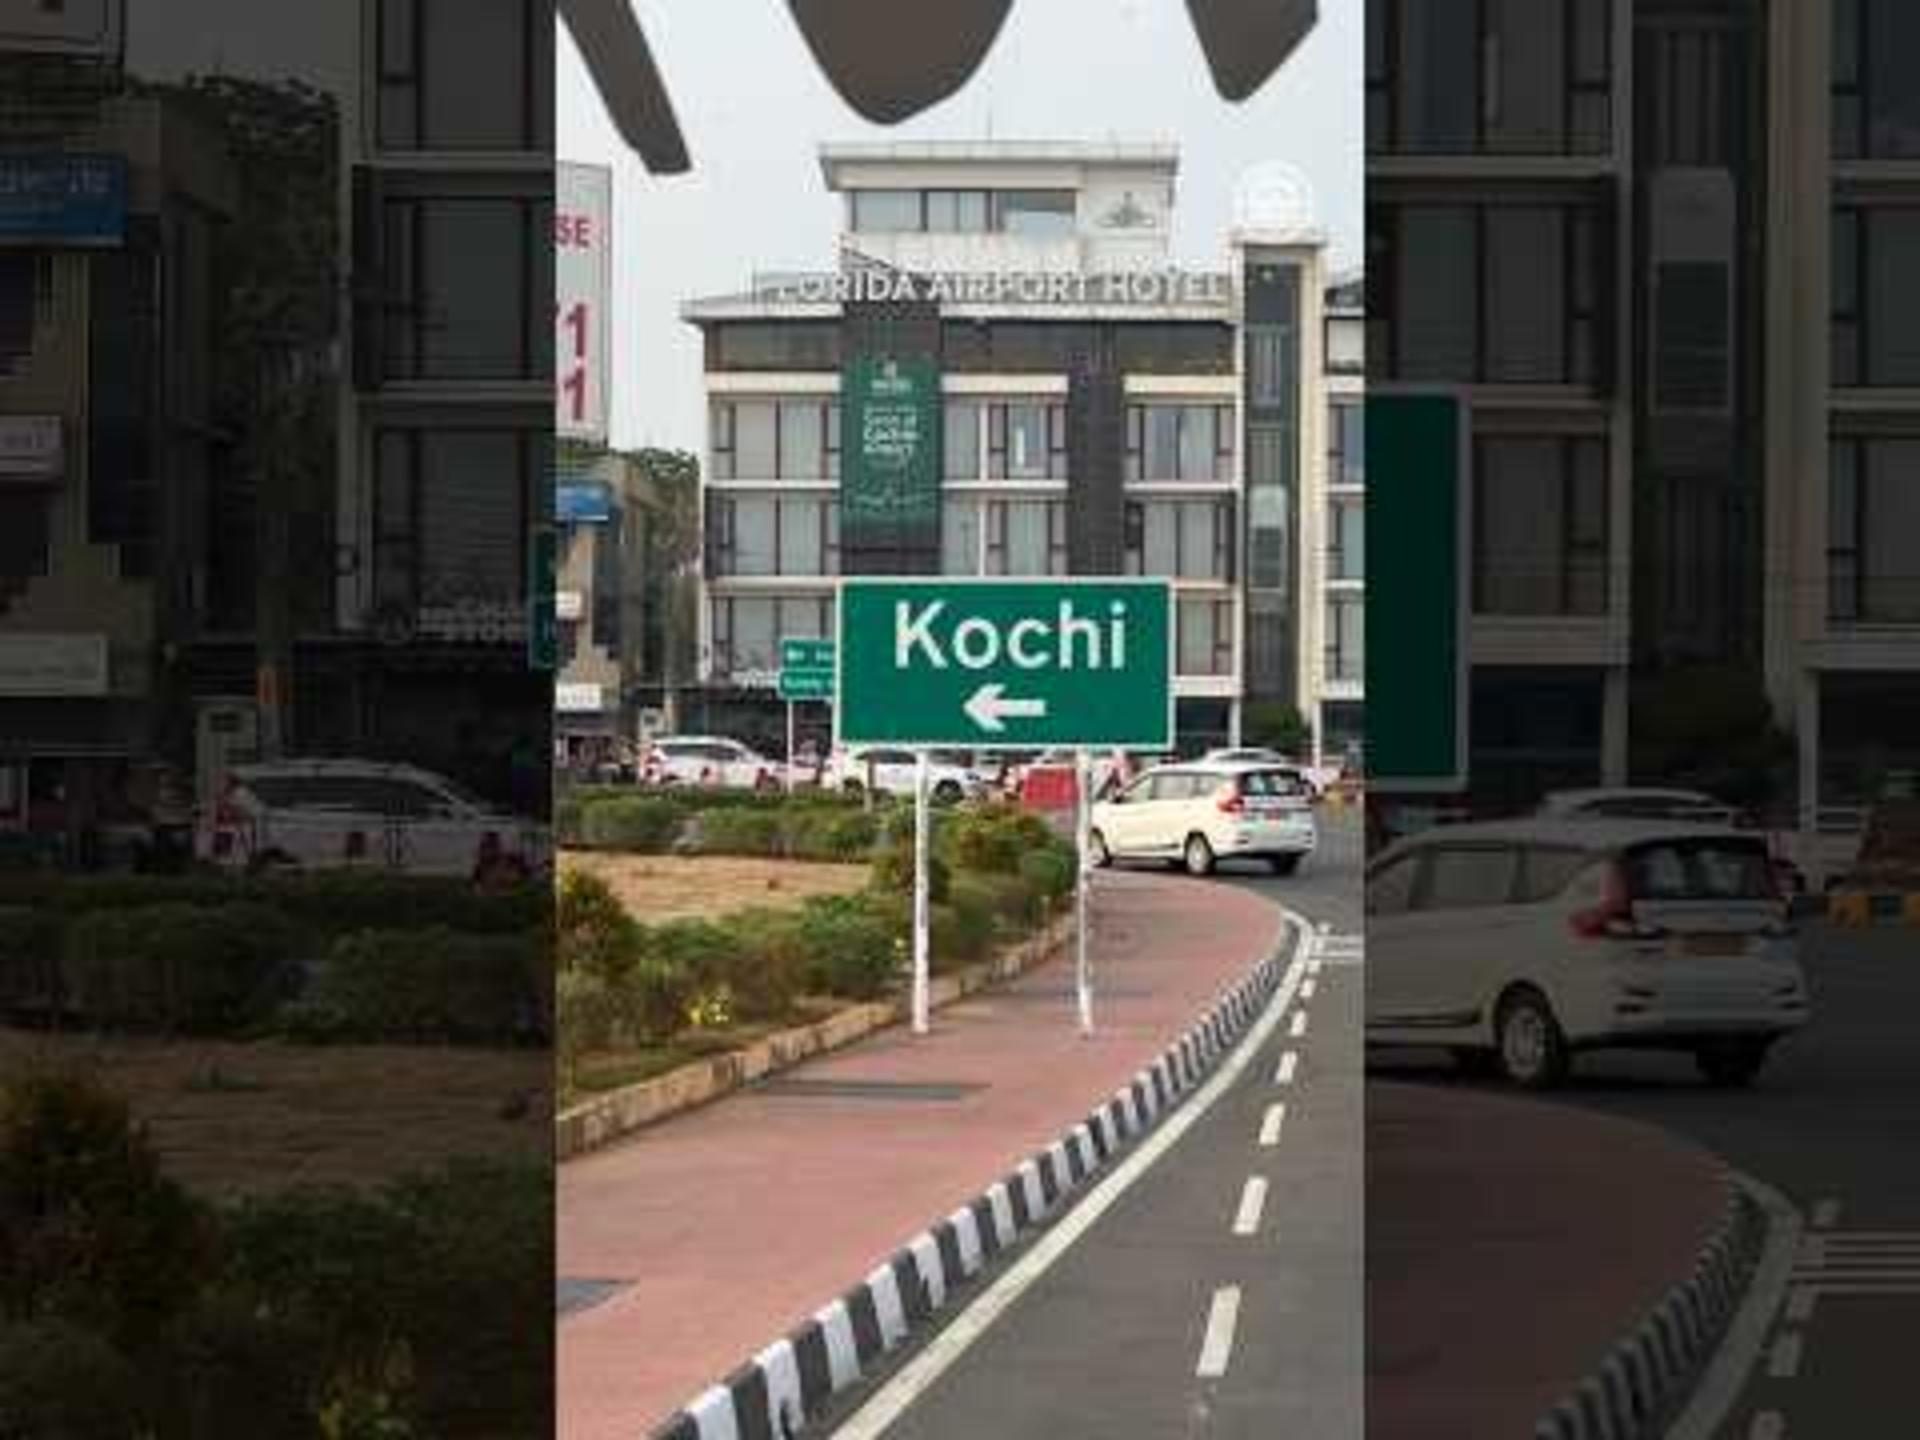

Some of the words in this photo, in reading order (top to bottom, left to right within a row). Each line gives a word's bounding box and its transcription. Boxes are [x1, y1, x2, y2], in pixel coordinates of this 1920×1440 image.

[774, 271, 917, 301] ORIDA
[927, 271, 1086, 301] AIRPORT
[1103, 271, 1229, 301] HOTEL
[895, 600, 1127, 670] Kochi
